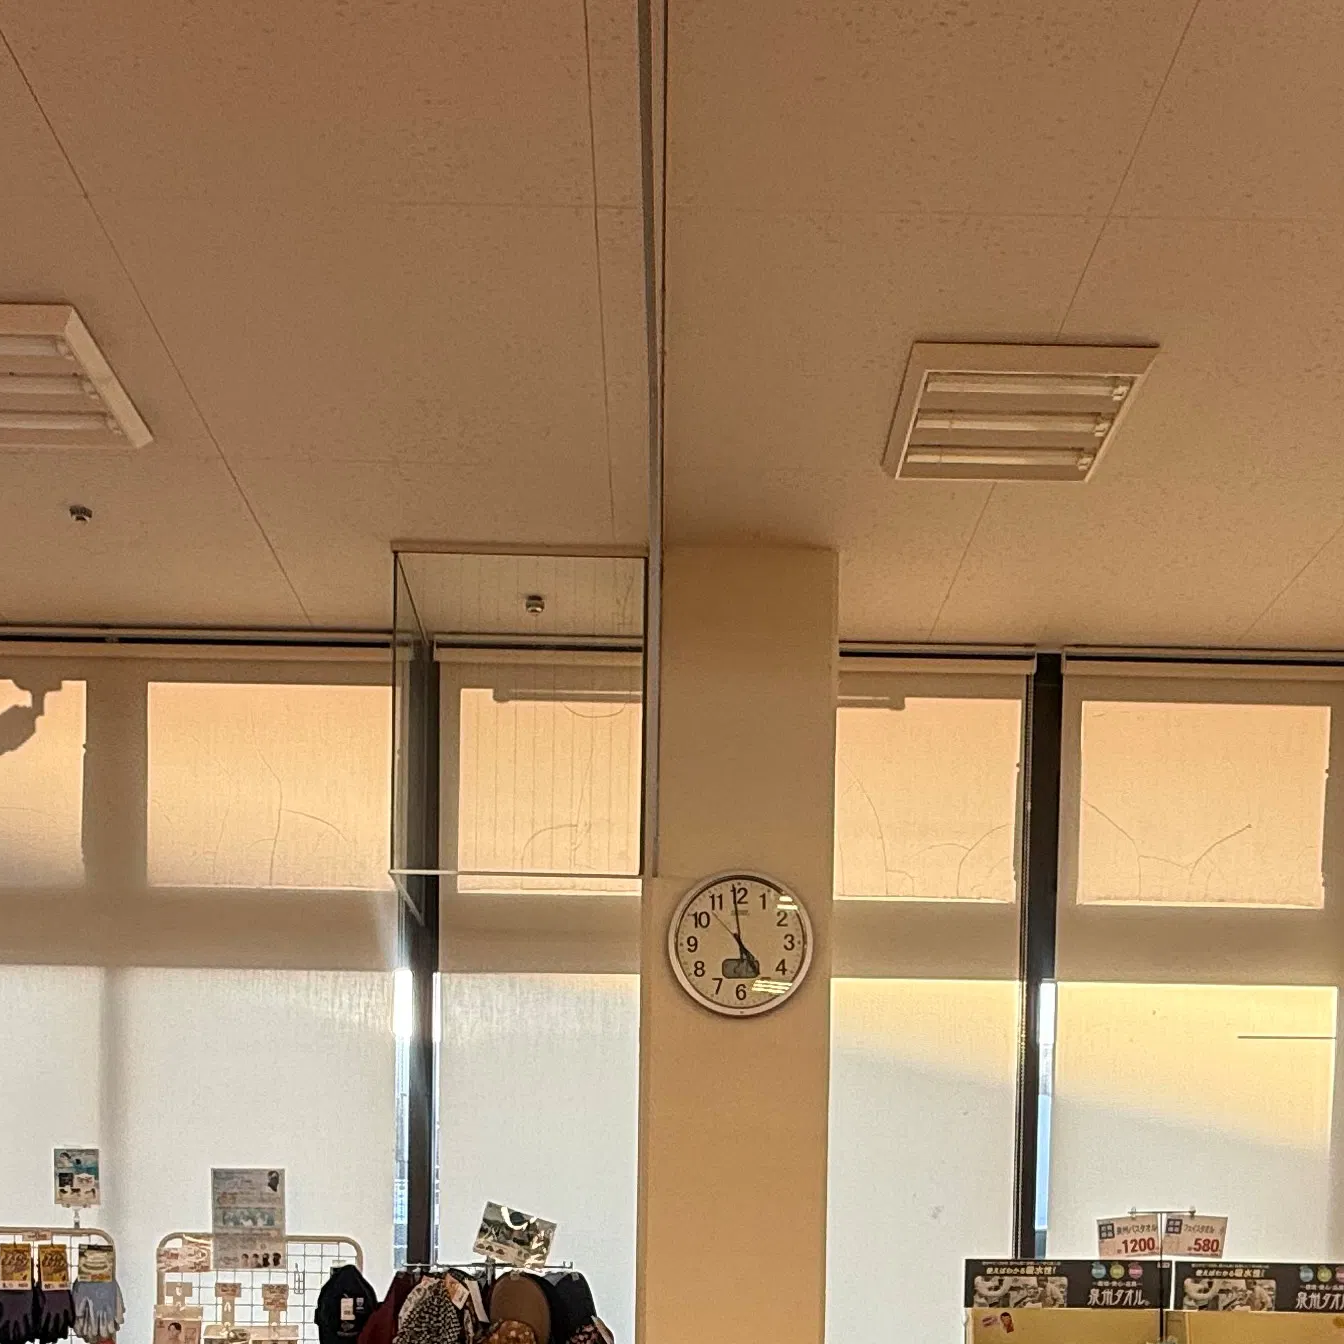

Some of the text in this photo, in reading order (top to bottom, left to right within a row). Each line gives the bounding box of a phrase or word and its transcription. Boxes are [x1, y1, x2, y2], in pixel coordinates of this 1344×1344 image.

[710, 894, 723, 911] 11
[760, 894, 766, 910] 1
[692, 911, 711, 928] 10
[776, 910, 788, 927] 2
[686, 936, 698, 953] 9
[783, 934, 795, 951] 3
[694, 960, 706, 977] 8
[775, 959, 787, 975] 4
[712, 978, 723, 995] 7
[735, 983, 747, 1000] 6
[1122, 1237, 1156, 1254] 1200
[1193, 1238, 1220, 1252] 580
[1086, 1288, 1145, 1306] 泉州タオル
